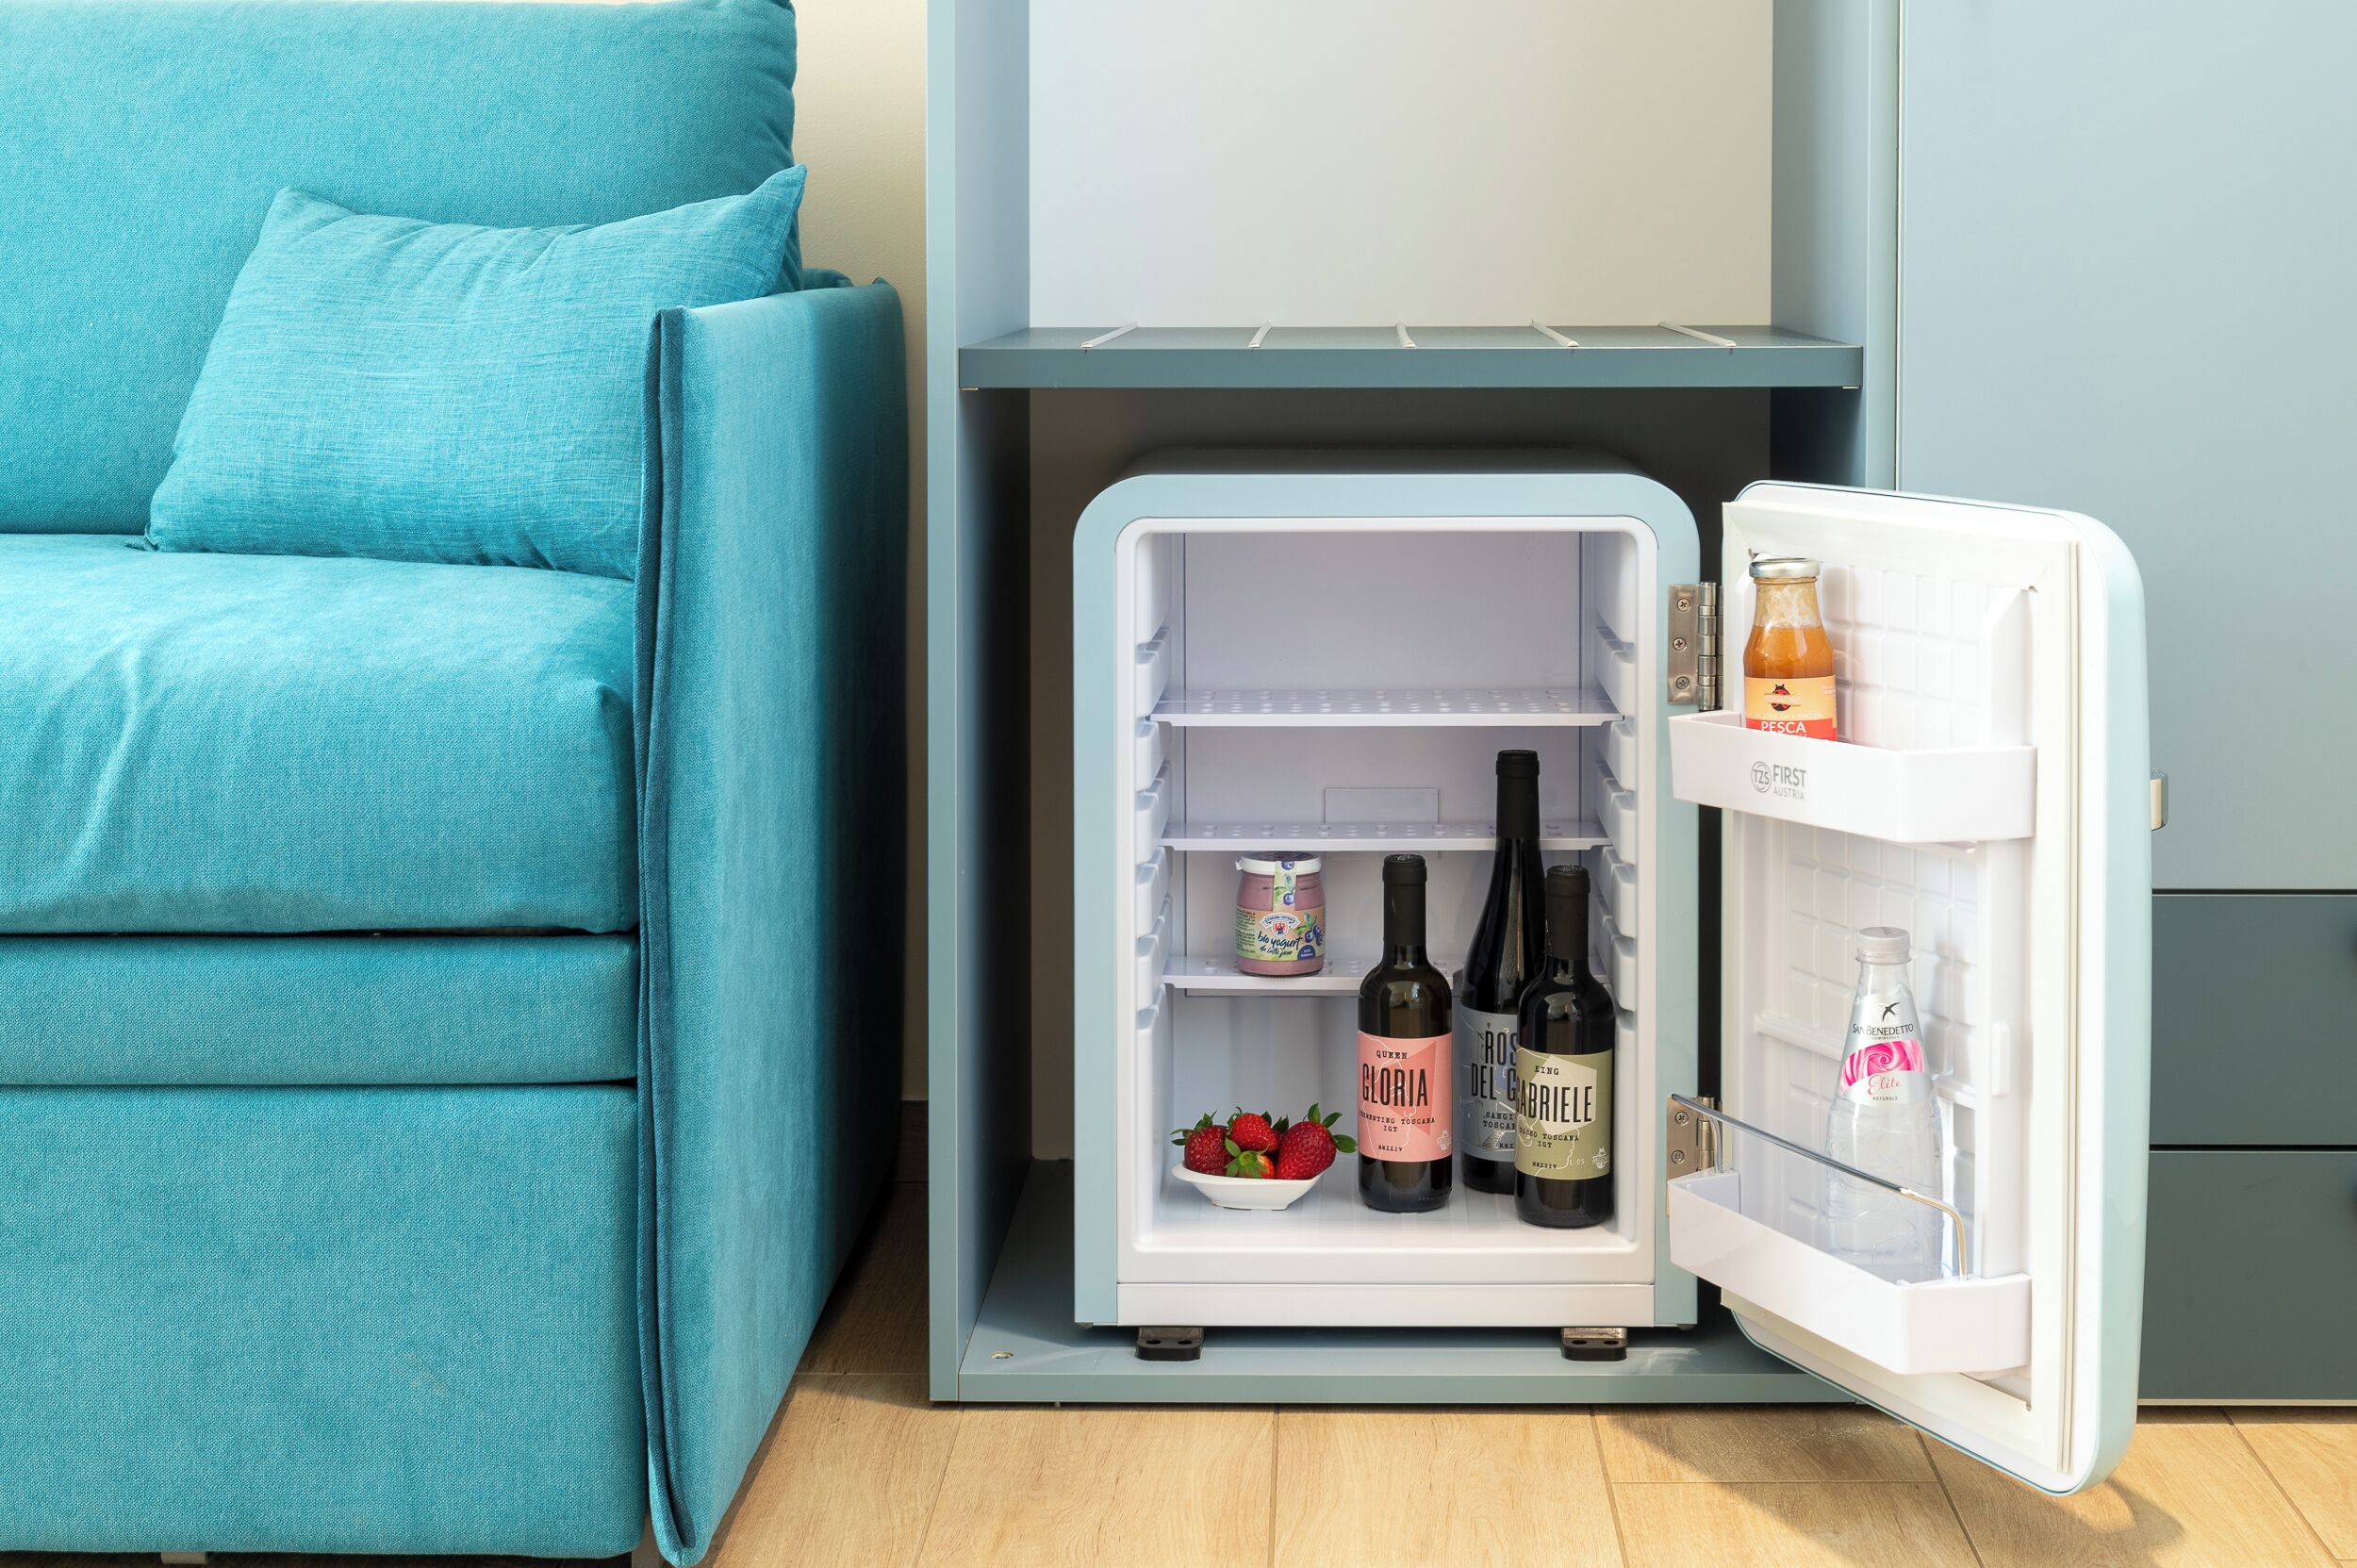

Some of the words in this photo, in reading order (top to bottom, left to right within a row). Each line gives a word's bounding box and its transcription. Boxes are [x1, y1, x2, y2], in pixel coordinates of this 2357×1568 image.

[1761, 721, 1807, 734] PESCA
[1753, 768, 1770, 785] TZS
[1773, 765, 1807, 788] FIRST
[1773, 785, 1805, 801] AUSTRIA
[1270, 936, 1303, 950] yogurt
[1867, 1023, 1914, 1036] BENEDETTO
[1376, 1049, 1408, 1059] QUEEN
[1535, 1065, 1559, 1076] KING
[1362, 1063, 1428, 1107] GLORIA
[1471, 1063, 1497, 1100] DEL
[1869, 1075, 1902, 1095] Elite
[1516, 1076, 1593, 1123] GABRIELE
[1401, 1116, 1436, 1125] TOSCANA
[1542, 1132, 1579, 1142] TOSCANA
[1538, 1140, 1552, 1148] IGT
